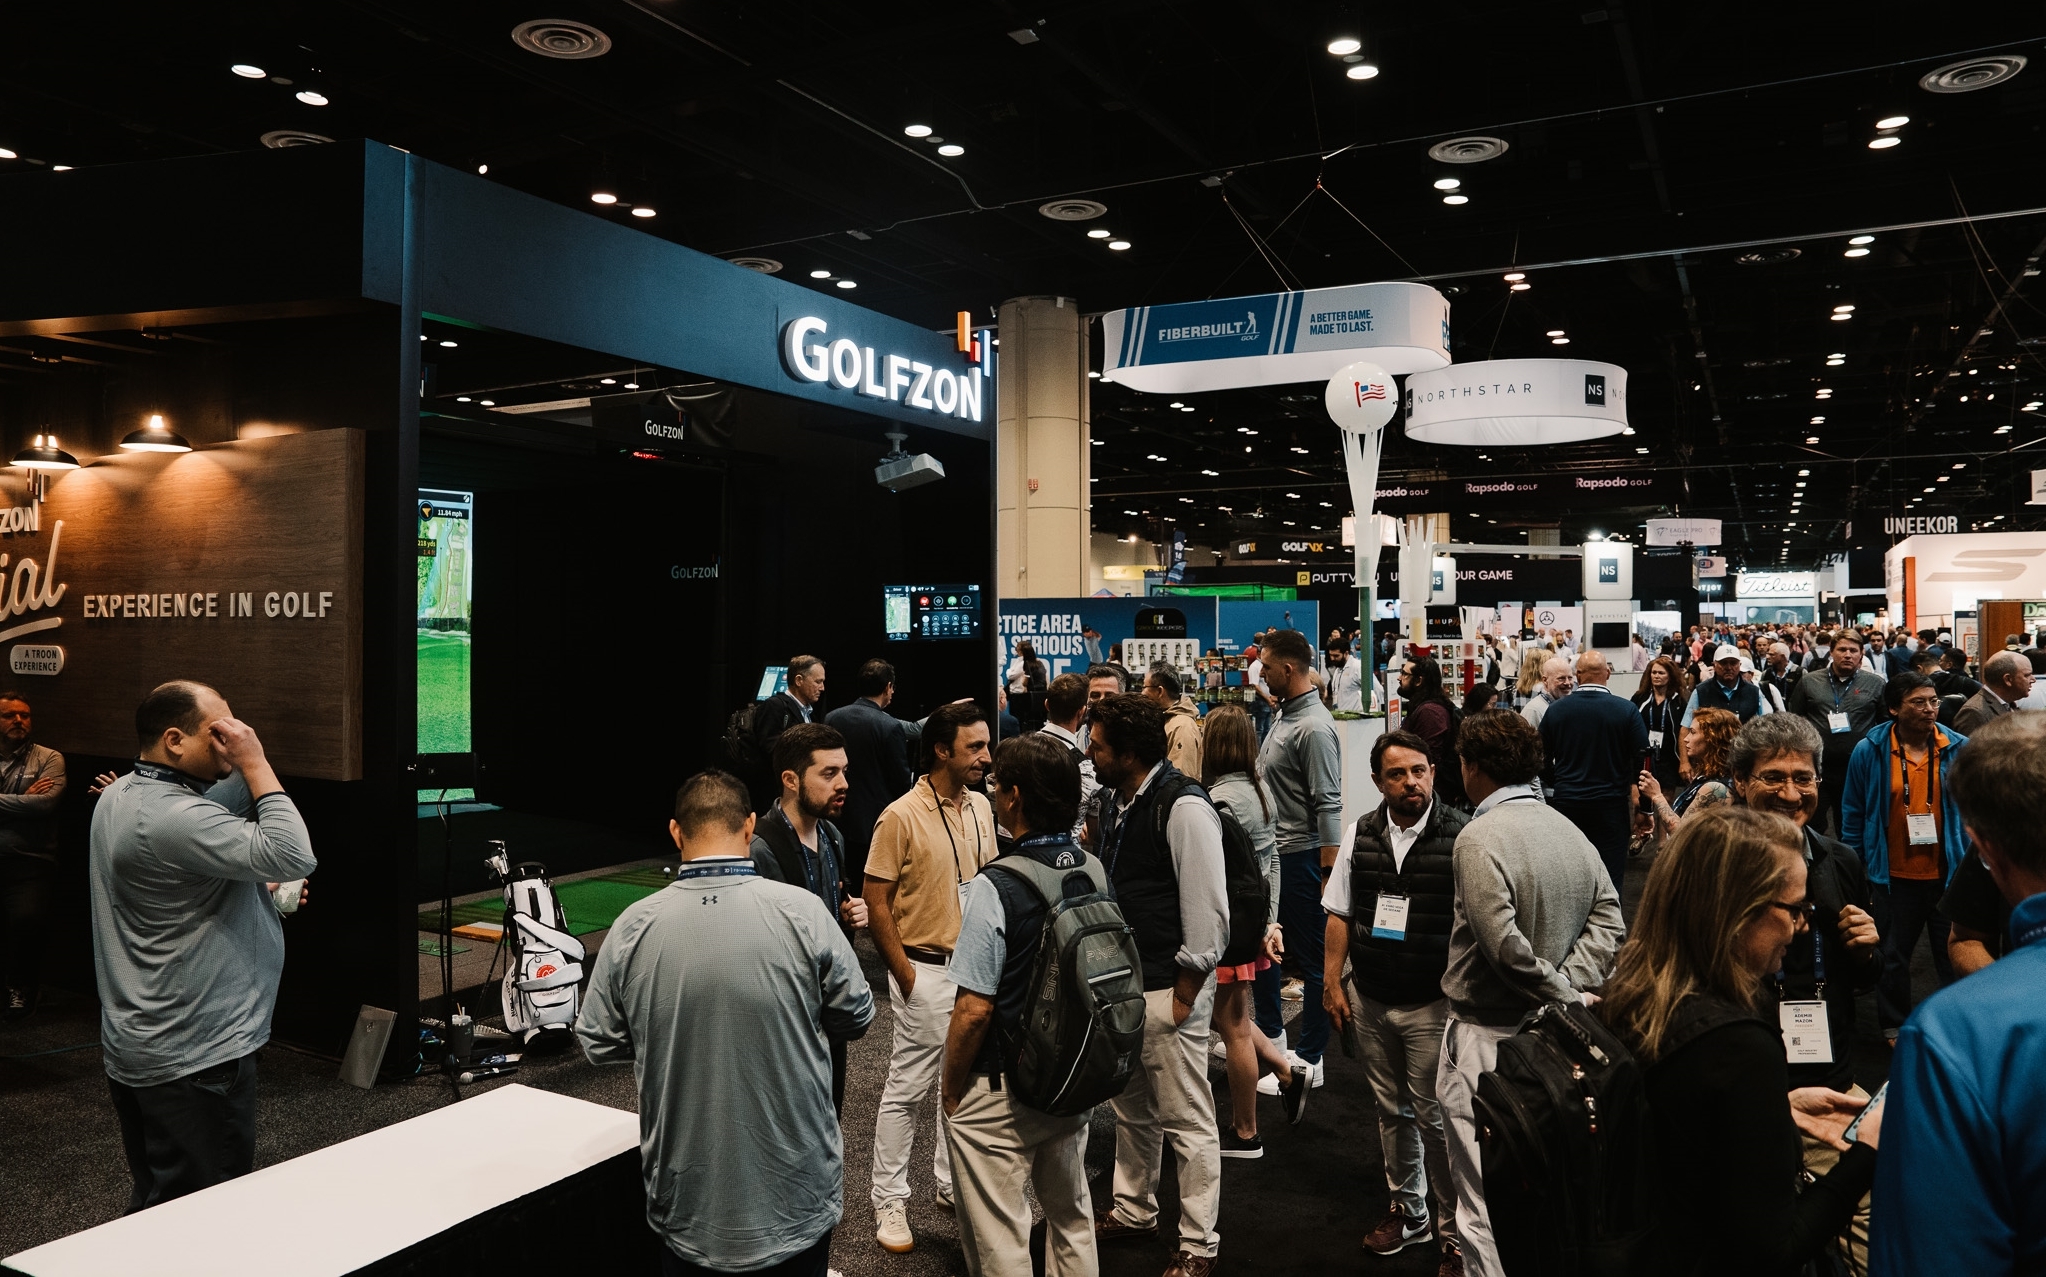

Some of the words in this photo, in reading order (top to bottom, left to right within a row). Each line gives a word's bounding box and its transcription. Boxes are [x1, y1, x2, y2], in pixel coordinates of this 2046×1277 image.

[1310, 313, 1315, 323] A
[1317, 311, 1347, 322] BETTER
[1347, 309, 1373, 320] GAME.
[1158, 321, 1243, 341] FIBERBUILT
[1310, 324, 1335, 335] MADE
[1336, 323, 1347, 334] TO
[1349, 320, 1374, 332] LAST.
[785, 316, 981, 422] GOLFZON
[1418, 383, 1531, 405] NORTHSTAR
[1588, 384, 1603, 396] NS
[645, 419, 684, 440] GOLFZON
[1466, 482, 1515, 494] Rapsodo
[1576, 477, 1628, 490] Rapsodo
[1884, 516, 1958, 534] UNEEKOR
[671, 564, 718, 579] GOLFZON
[1479, 570, 1513, 580] GAME
[1601, 566, 1616, 575] NS
[1738, 576, 1812, 595] Titleist
[83, 592, 218, 618] EXPERIENCE
[229, 592, 253, 617] IN
[264, 591, 333, 618] GOLF
[1040, 614, 1082, 634] AREA
[25, 650, 30, 658] A
[32, 650, 57, 659] TROON
[15, 662, 57, 671] EXPERIENCE
[1087, 945, 1117, 962] PING
